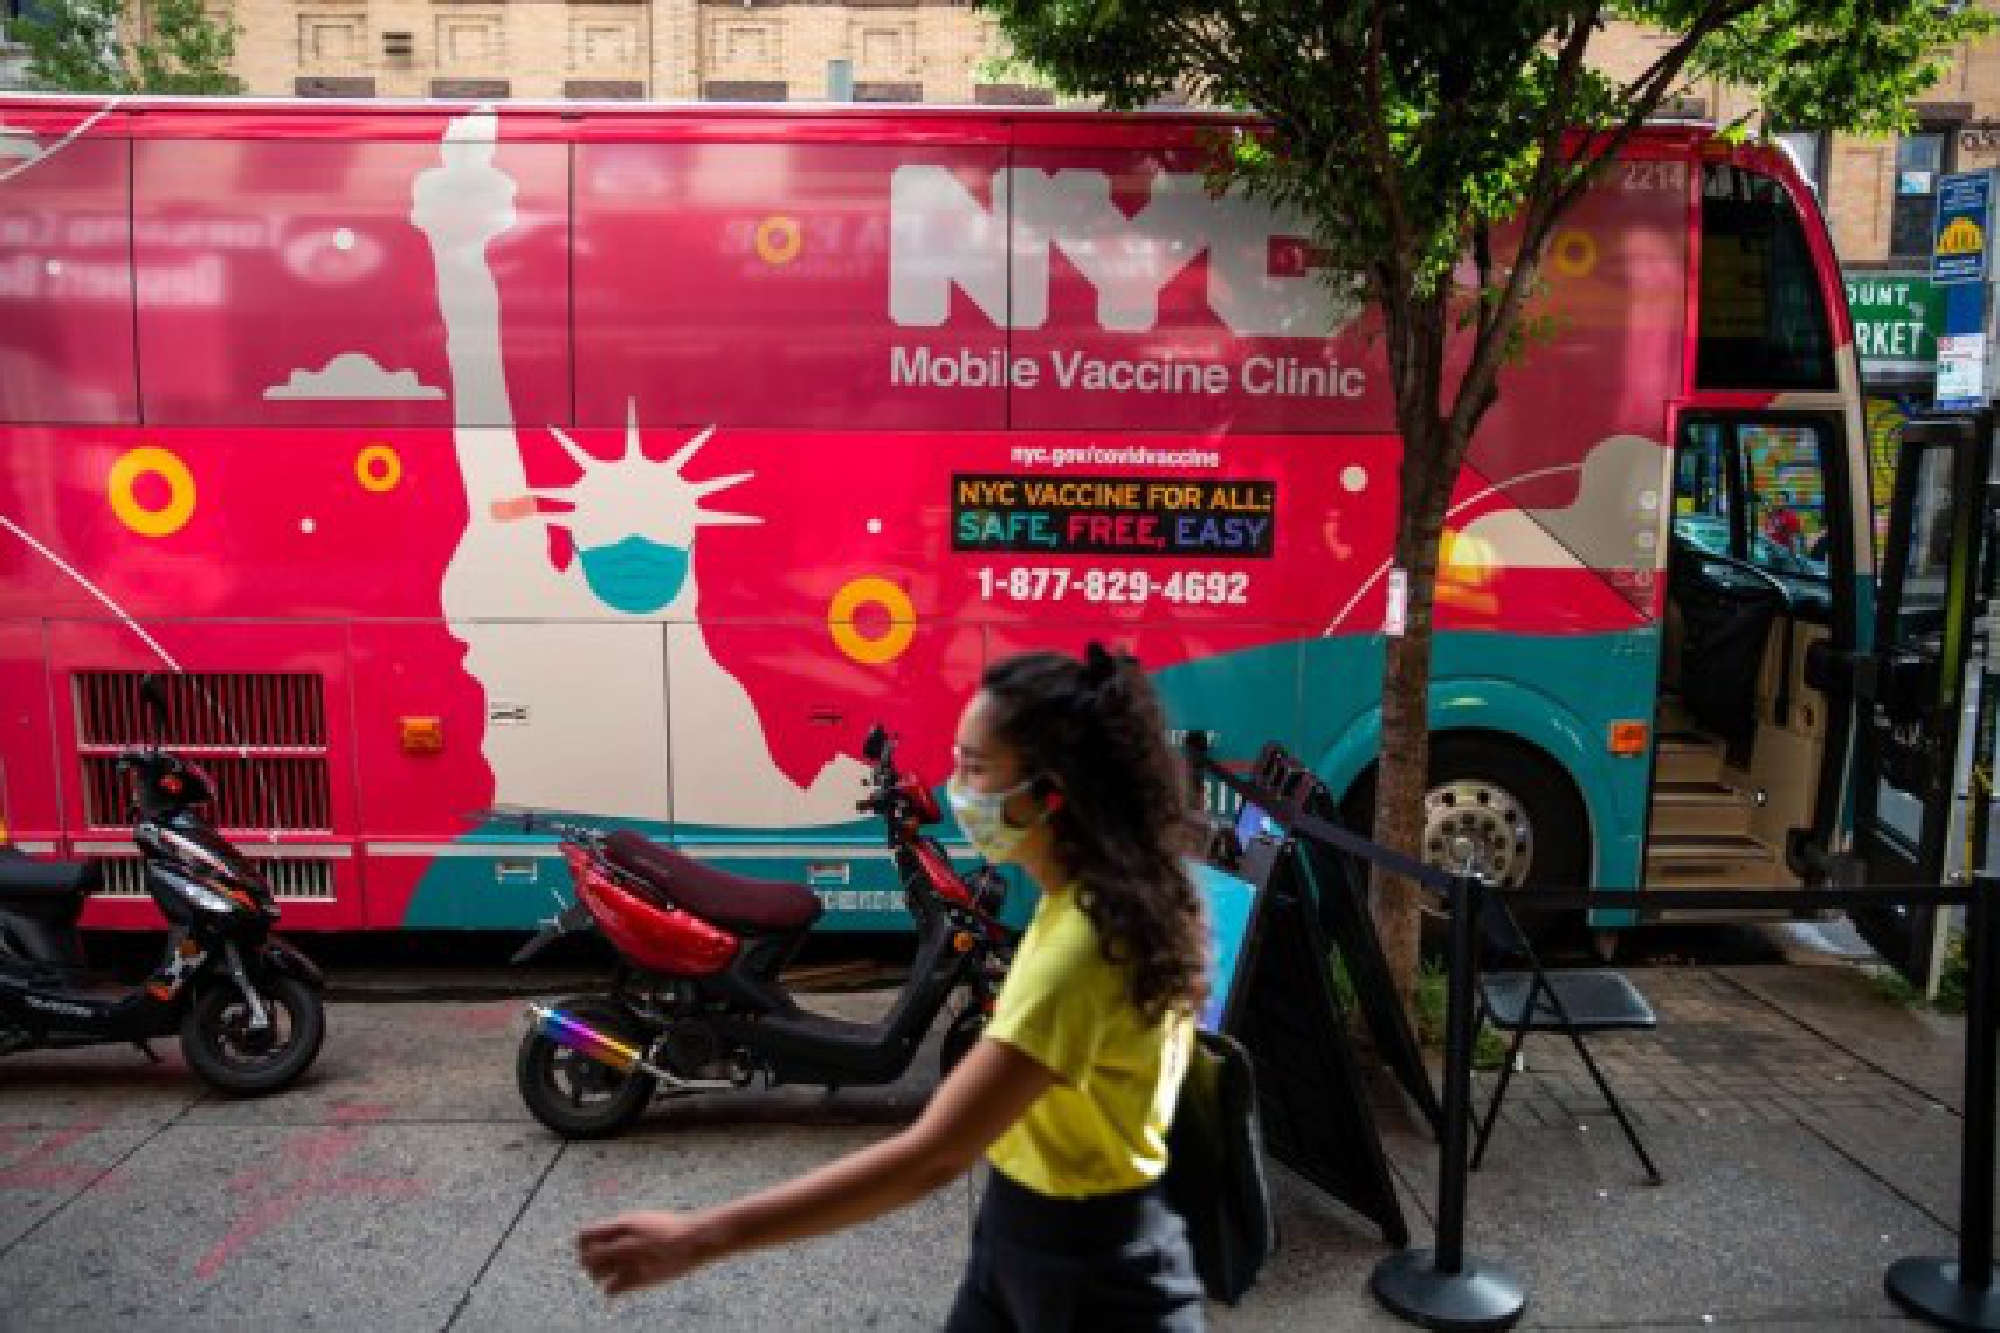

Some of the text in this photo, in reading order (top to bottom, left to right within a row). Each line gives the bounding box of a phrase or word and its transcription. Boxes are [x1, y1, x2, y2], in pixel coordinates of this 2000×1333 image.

[888, 165, 1366, 338] NYC
[889, 346, 1367, 398] Mobile Vaccine Clinic
[1010, 444, 1220, 468] nyc.gov/covidvaccine
[958, 480, 1272, 512] NYC VACCINE FOR ALL:
[958, 511, 1269, 550] SAFE, FREE, EASY
[978, 566, 1250, 605] 1-877-829-4692
